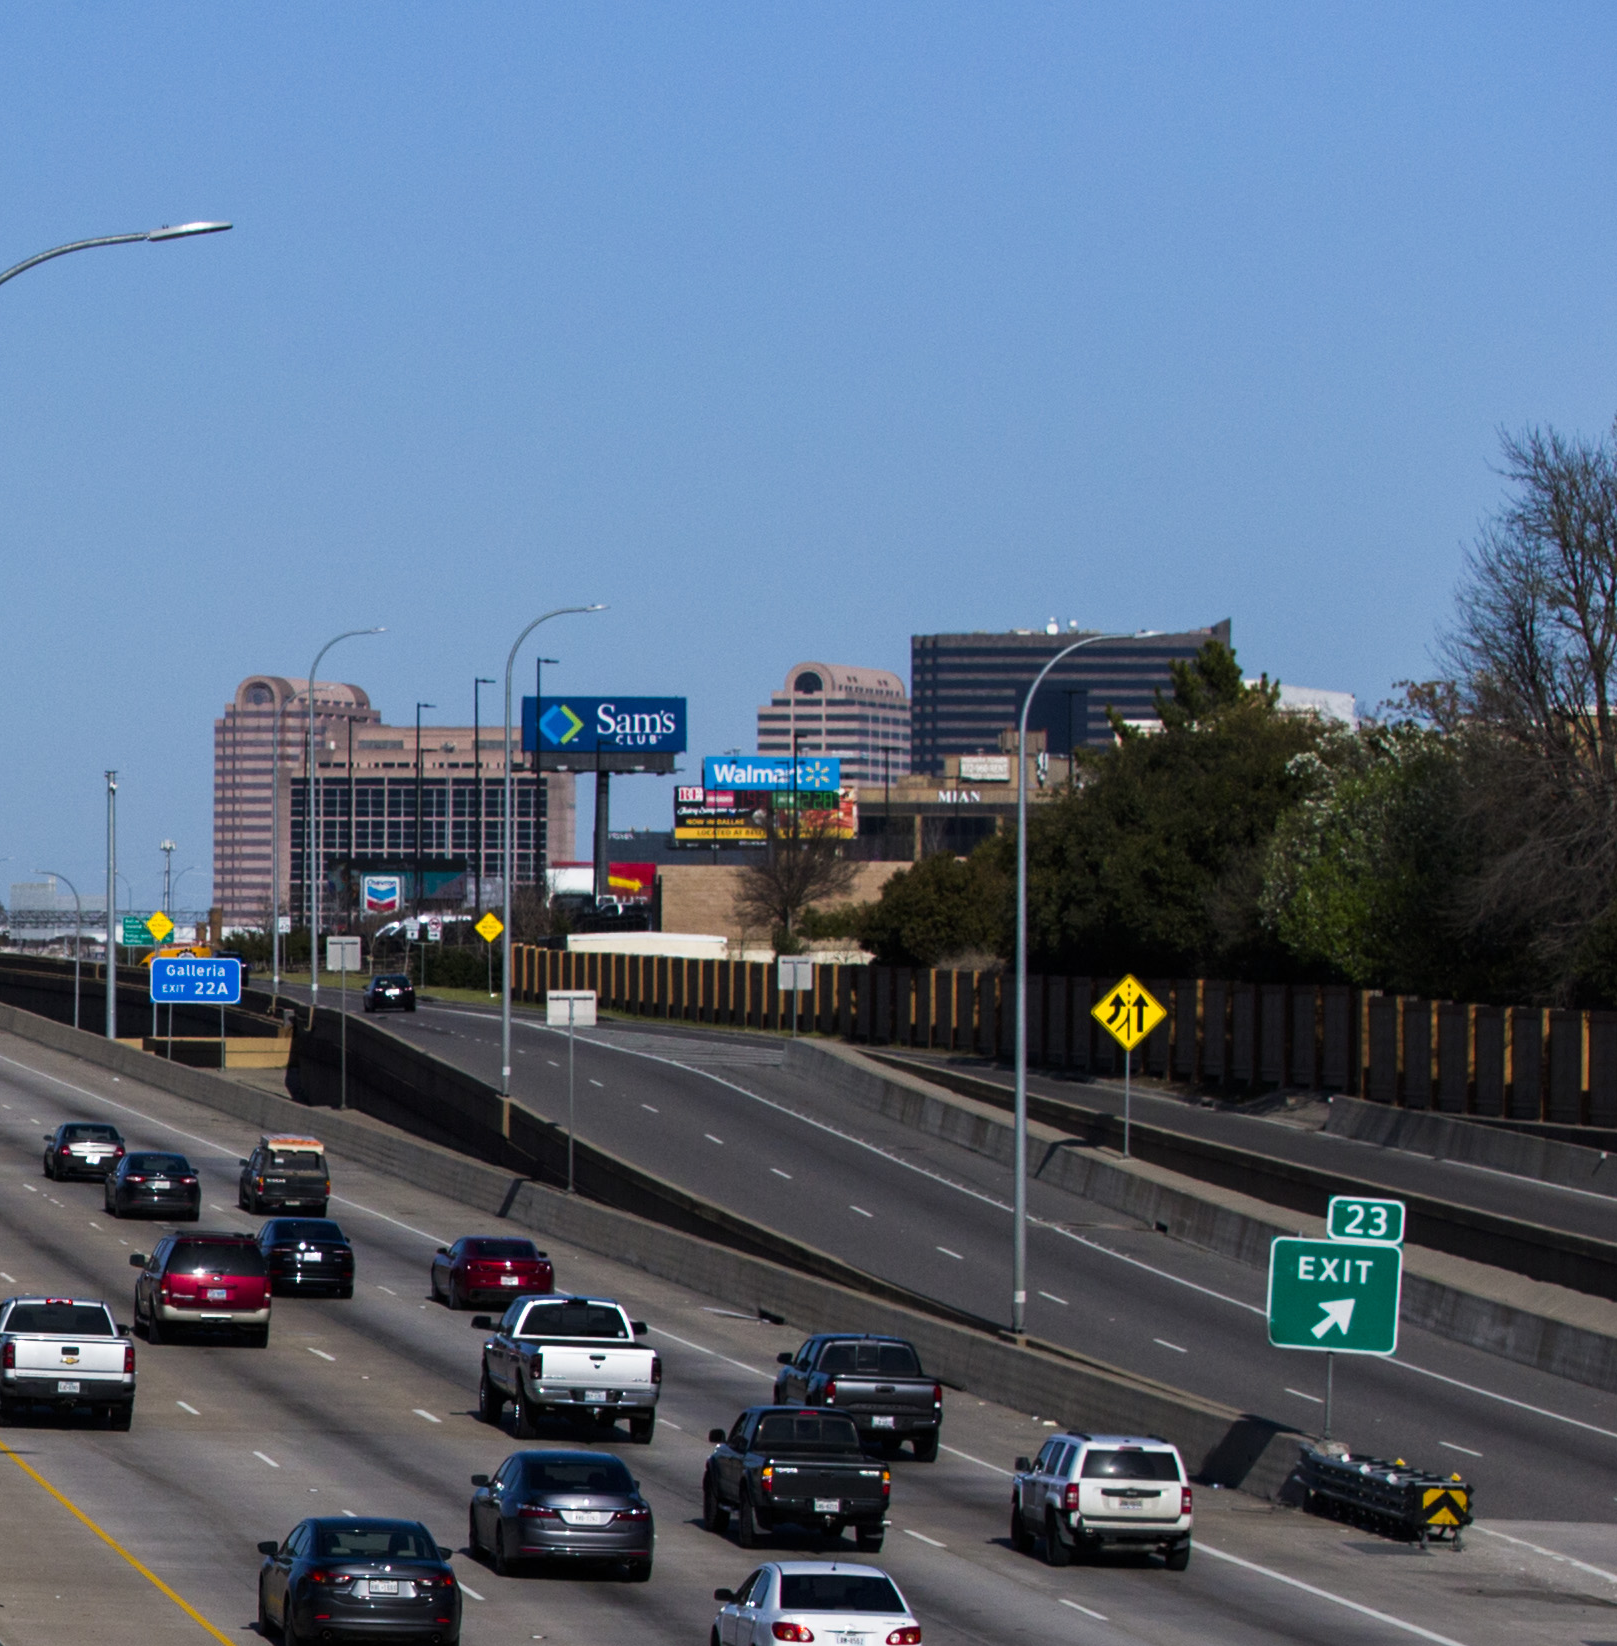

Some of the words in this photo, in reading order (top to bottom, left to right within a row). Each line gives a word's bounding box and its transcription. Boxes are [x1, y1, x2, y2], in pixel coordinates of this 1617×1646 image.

[597, 703, 675, 734] Sam's
[615, 734, 657, 745] CLUB
[713, 764, 802, 784] Walmart
[938, 790, 980, 803] MIAN
[367, 879, 397, 887] Chevron
[166, 964, 226, 977] Galleria
[162, 984, 186, 993] EXIT
[194, 982, 229, 995] 22A
[1344, 1204, 1388, 1237] 23
[1297, 1255, 1374, 1285] EXIT
